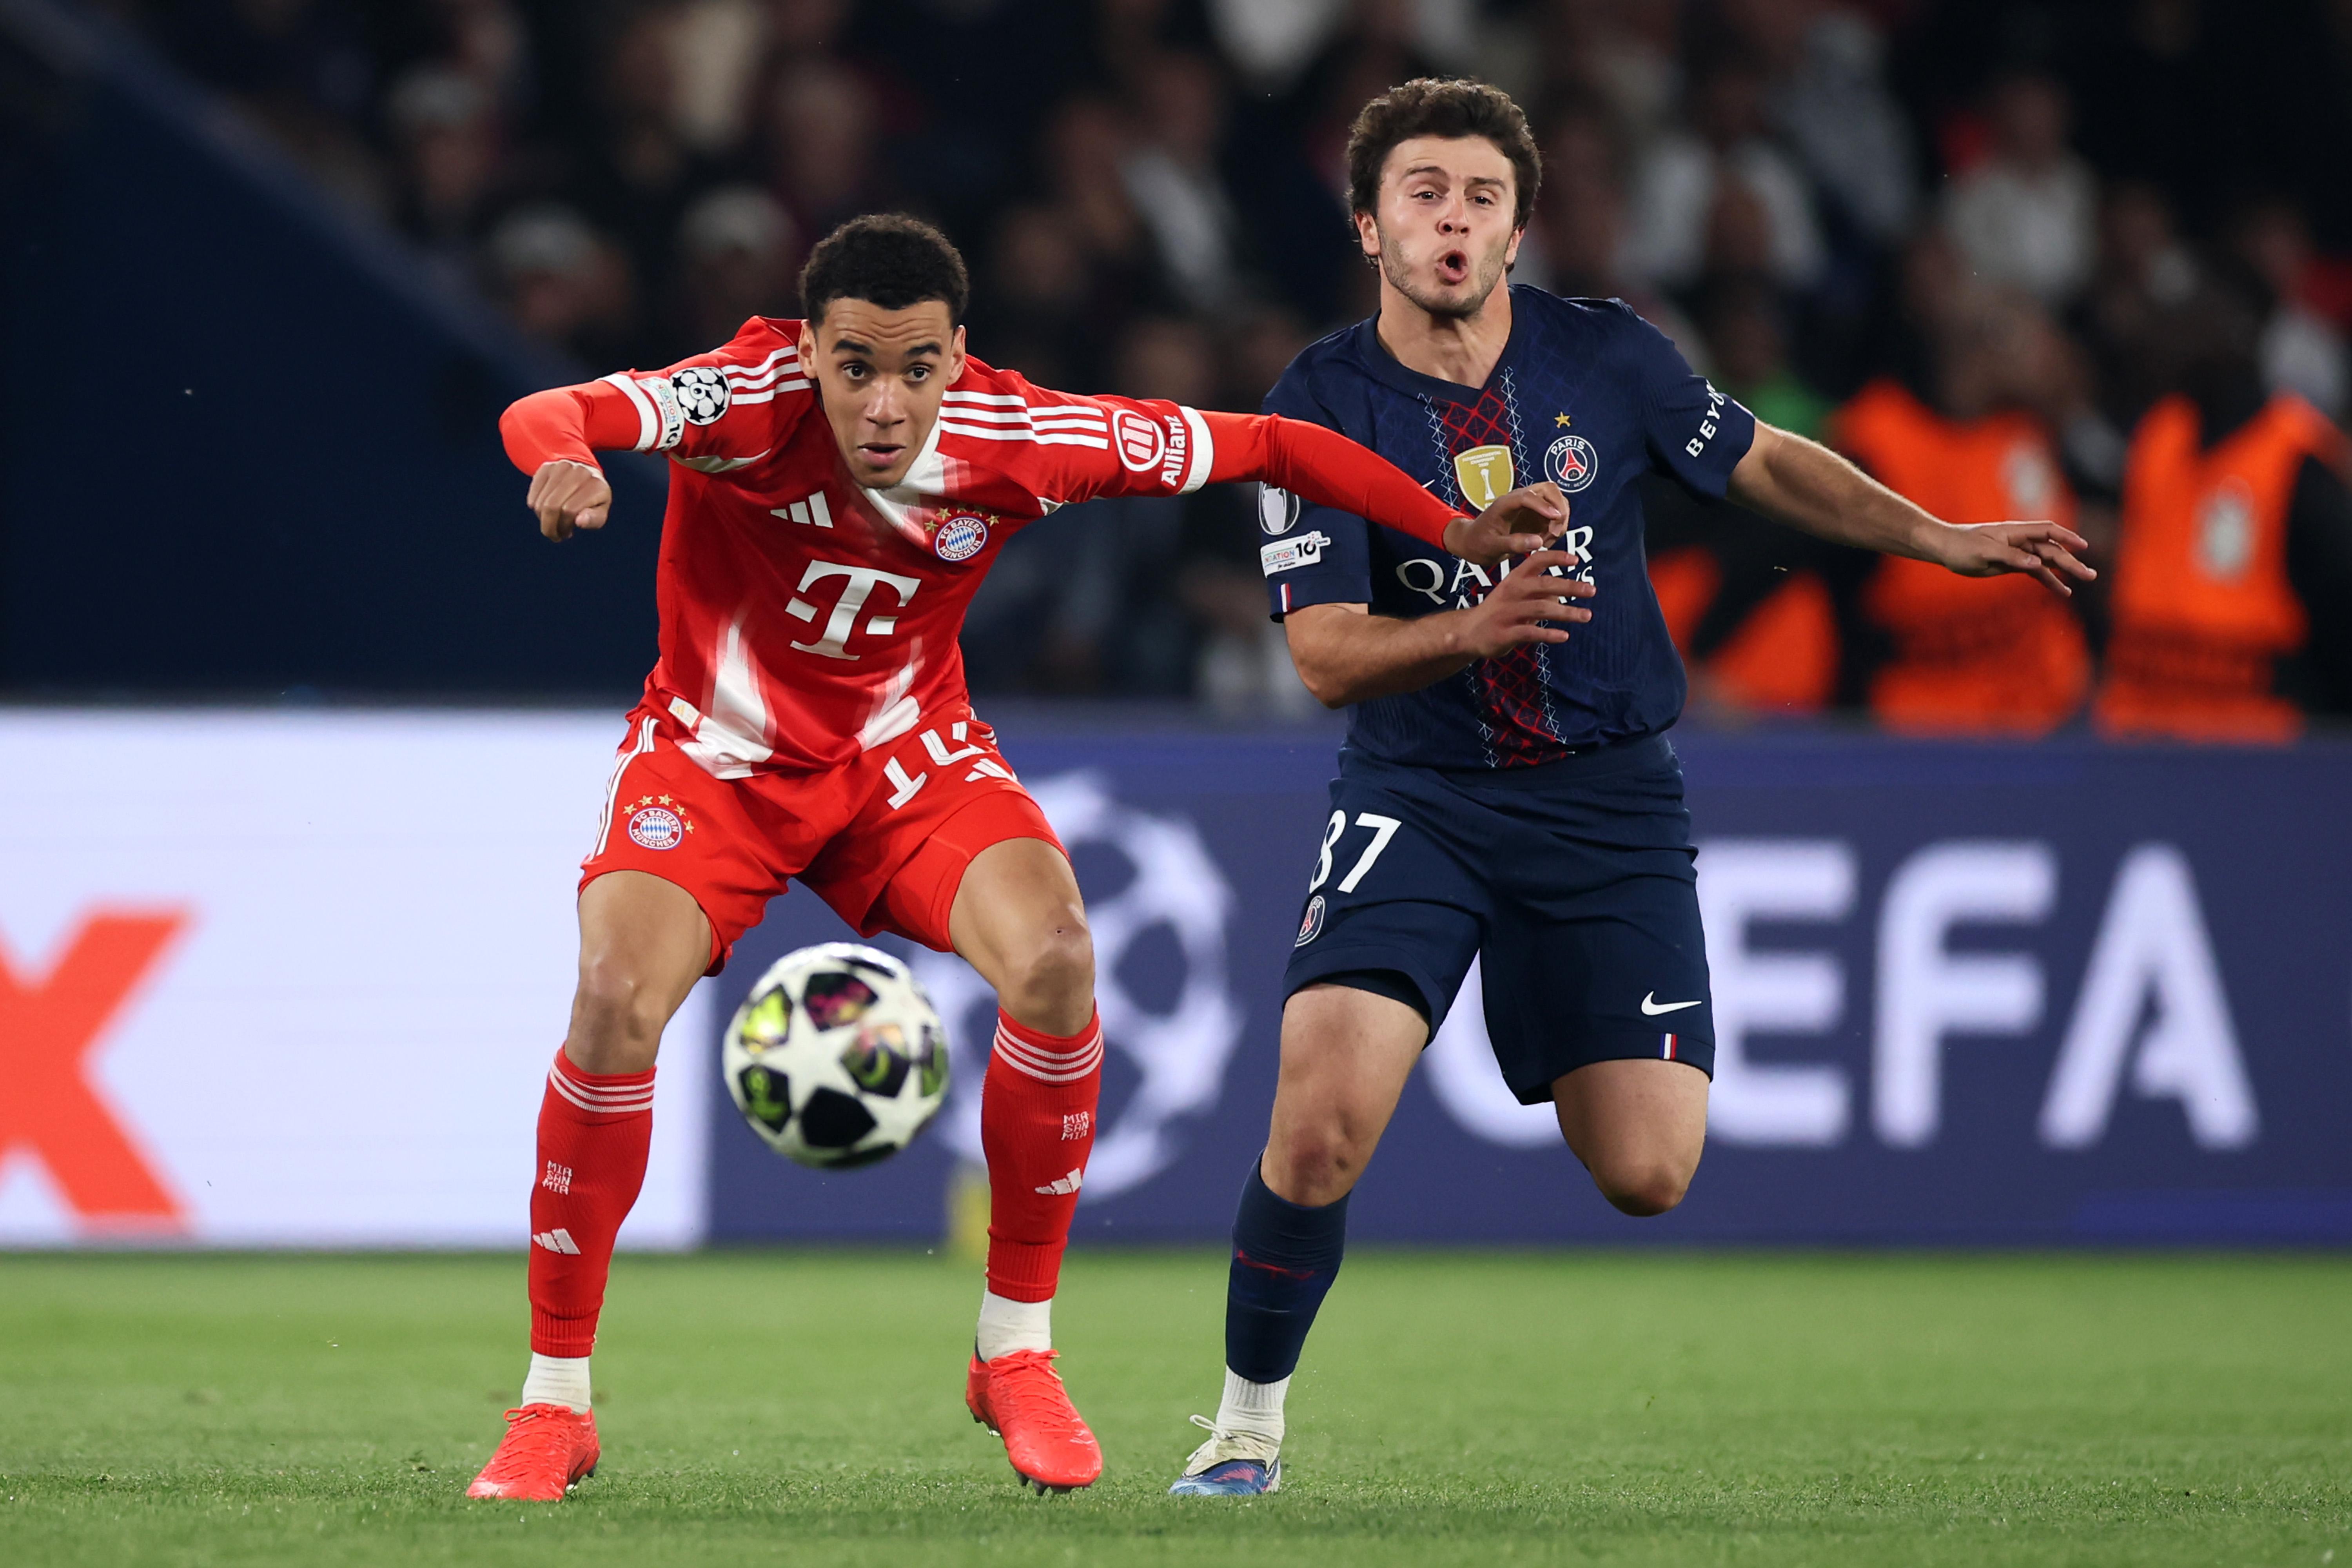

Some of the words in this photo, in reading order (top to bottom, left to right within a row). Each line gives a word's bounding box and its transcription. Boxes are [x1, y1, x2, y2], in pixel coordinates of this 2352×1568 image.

[1161, 415, 1186, 486] Allianz
[1550, 438, 1585, 455] PARIS
[940, 528, 950, 539] FC
[951, 520, 983, 534] BAYERN
[635, 813, 648, 823] FC
[648, 810, 679, 833] BAYERN
[1309, 810, 1402, 894] 87
[1063, 1111, 1089, 1123] MIA
[1061, 1129, 1087, 1140] MIA
[1063, 1120, 1089, 1132] SAN
[547, 1160, 572, 1177] MIA
[543, 1178, 569, 1195] MIA
[546, 1170, 571, 1186] SAN
